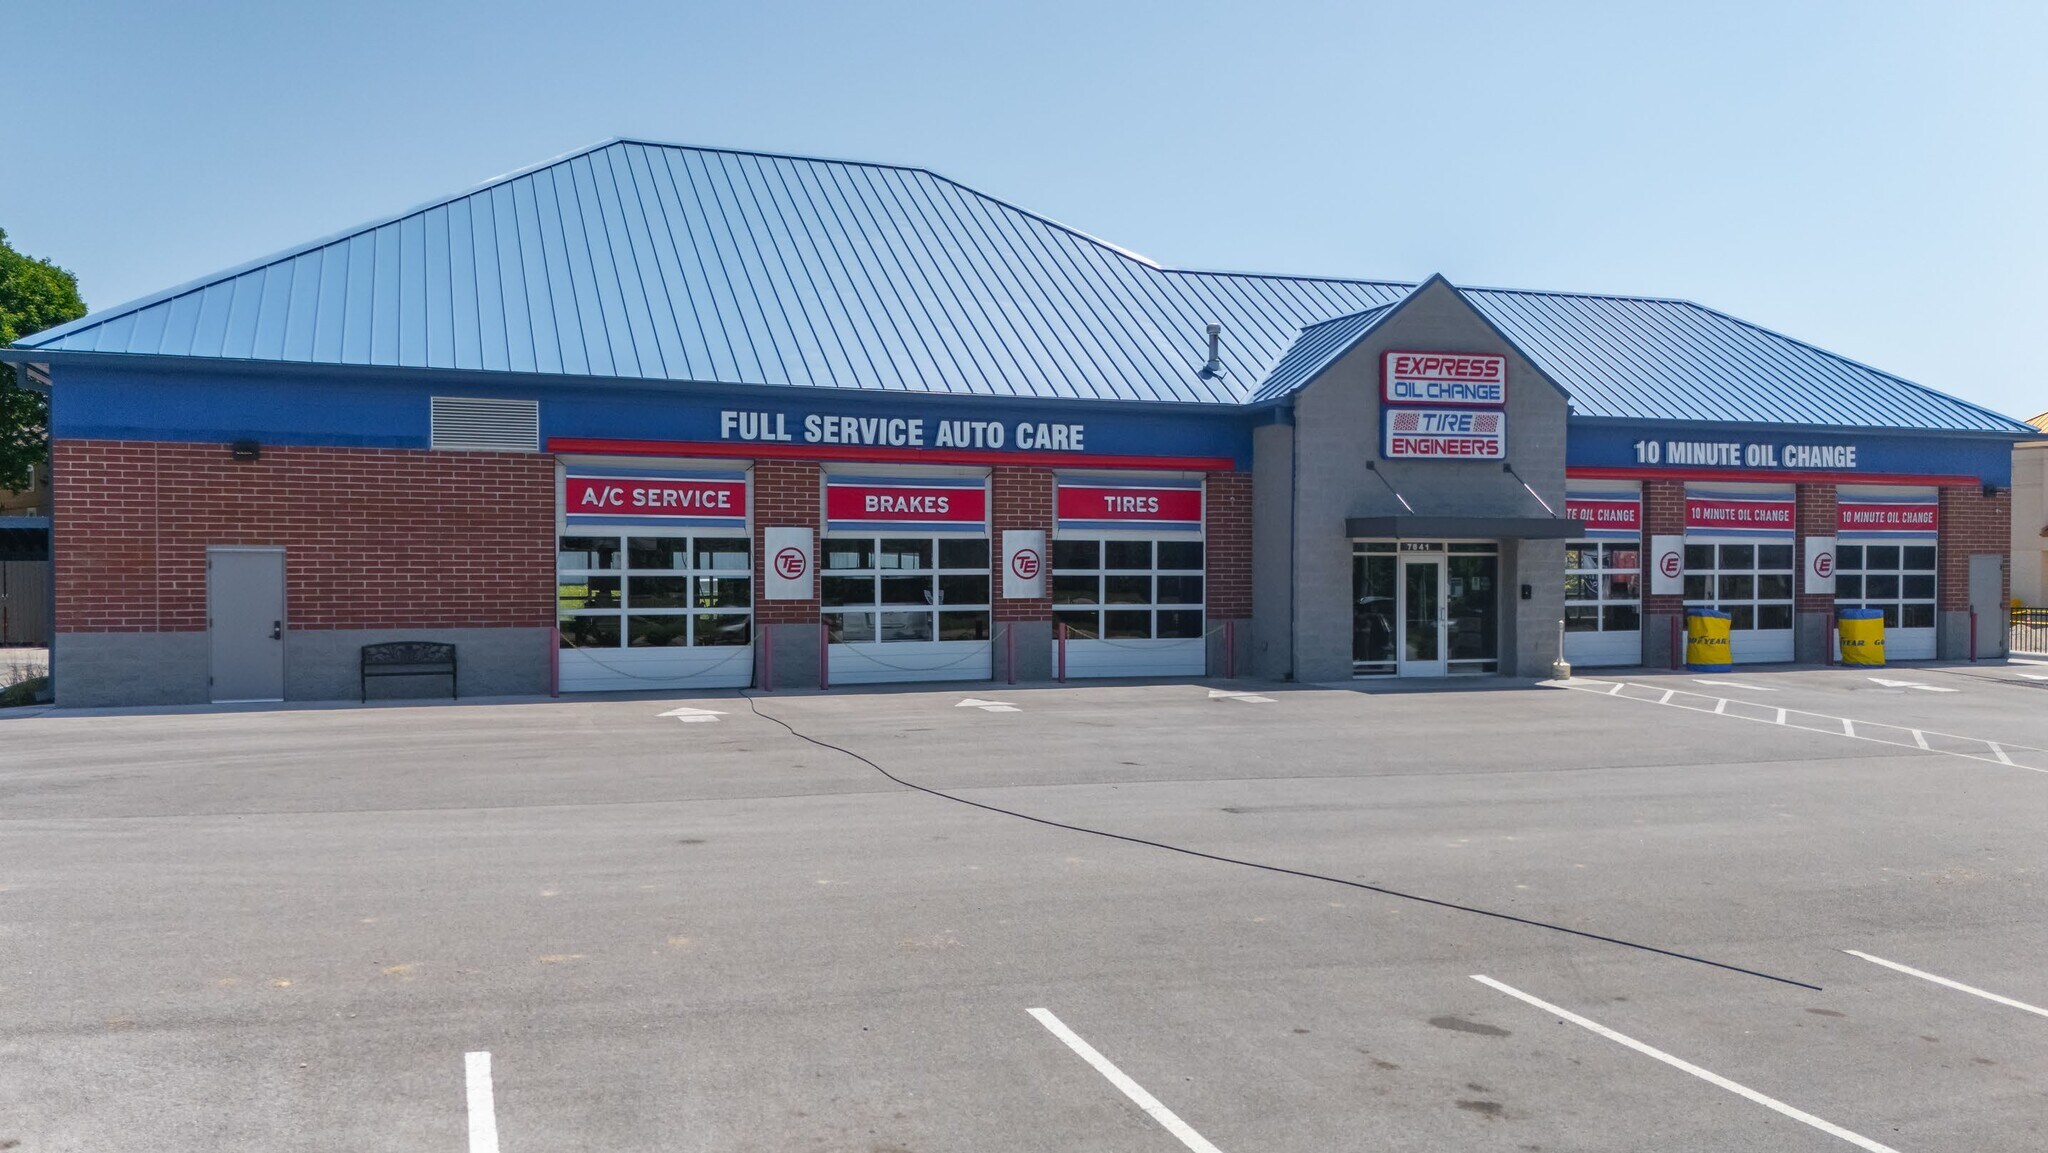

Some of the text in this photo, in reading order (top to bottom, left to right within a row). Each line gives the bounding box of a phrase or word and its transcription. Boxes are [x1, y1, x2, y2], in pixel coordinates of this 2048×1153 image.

[1394, 356, 1500, 377] EXPRESS
[1394, 382, 1500, 400] OIL CHANGE
[720, 411, 1084, 450] FULL SERVICE AUTO CARE
[1422, 413, 1473, 432] TIRE
[1392, 438, 1499, 455] ENGINEERS
[1634, 440, 1857, 468] 10 MINUTE OIL CHANGE
[581, 486, 731, 508] A/C SERVICE
[865, 495, 950, 513] BRAKES
[1104, 495, 1159, 513] TIRES
[1580, 508, 1595, 521] OIL
[1597, 509, 1635, 522] CHANGE
[1691, 507, 1790, 522] 10 MINUTE OIL CHANGE
[1842, 511, 1933, 524] 10 MINUTE OIL CHANGE
[779, 554, 804, 573] TE
[1016, 555, 1038, 574] TE
[1665, 557, 1679, 572] E
[1819, 558, 1832, 572] E
